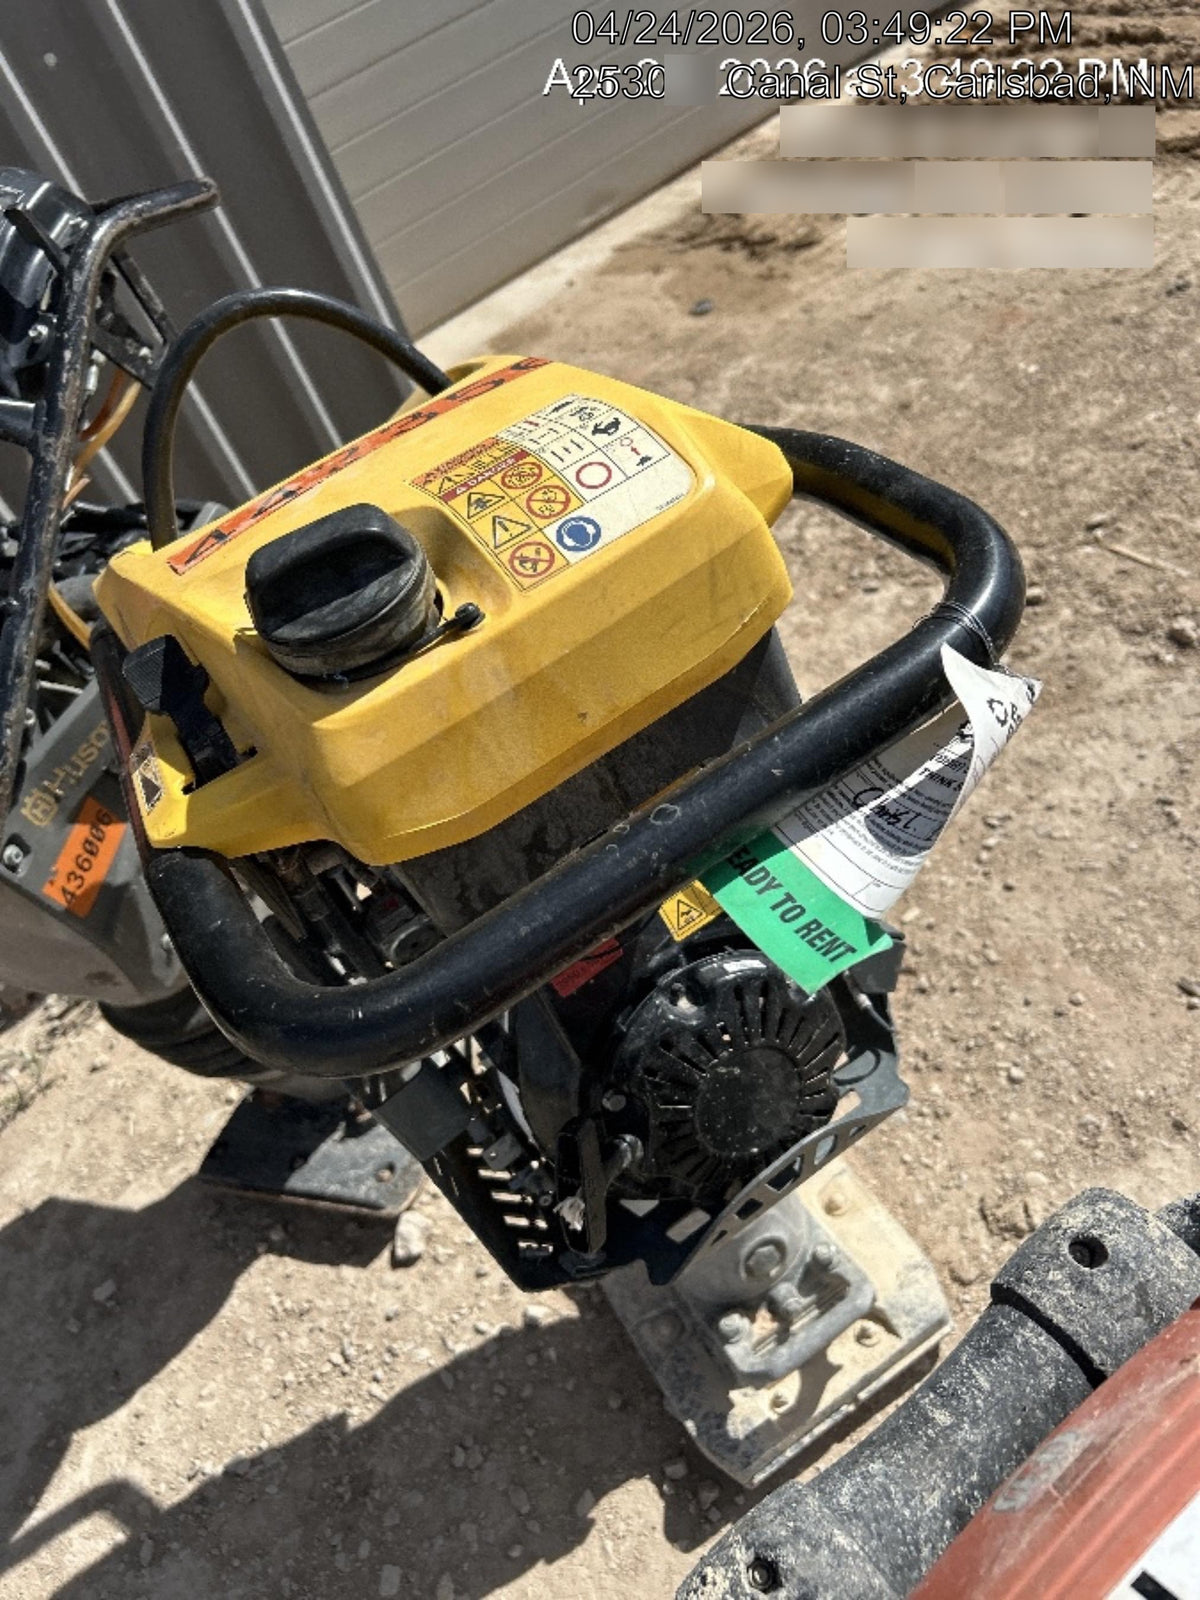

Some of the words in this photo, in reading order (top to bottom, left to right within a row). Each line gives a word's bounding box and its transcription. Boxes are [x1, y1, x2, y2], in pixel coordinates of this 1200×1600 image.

[727, 845, 784, 896] EADY
[769, 891, 807, 924] TO
[793, 918, 859, 964] RENT
